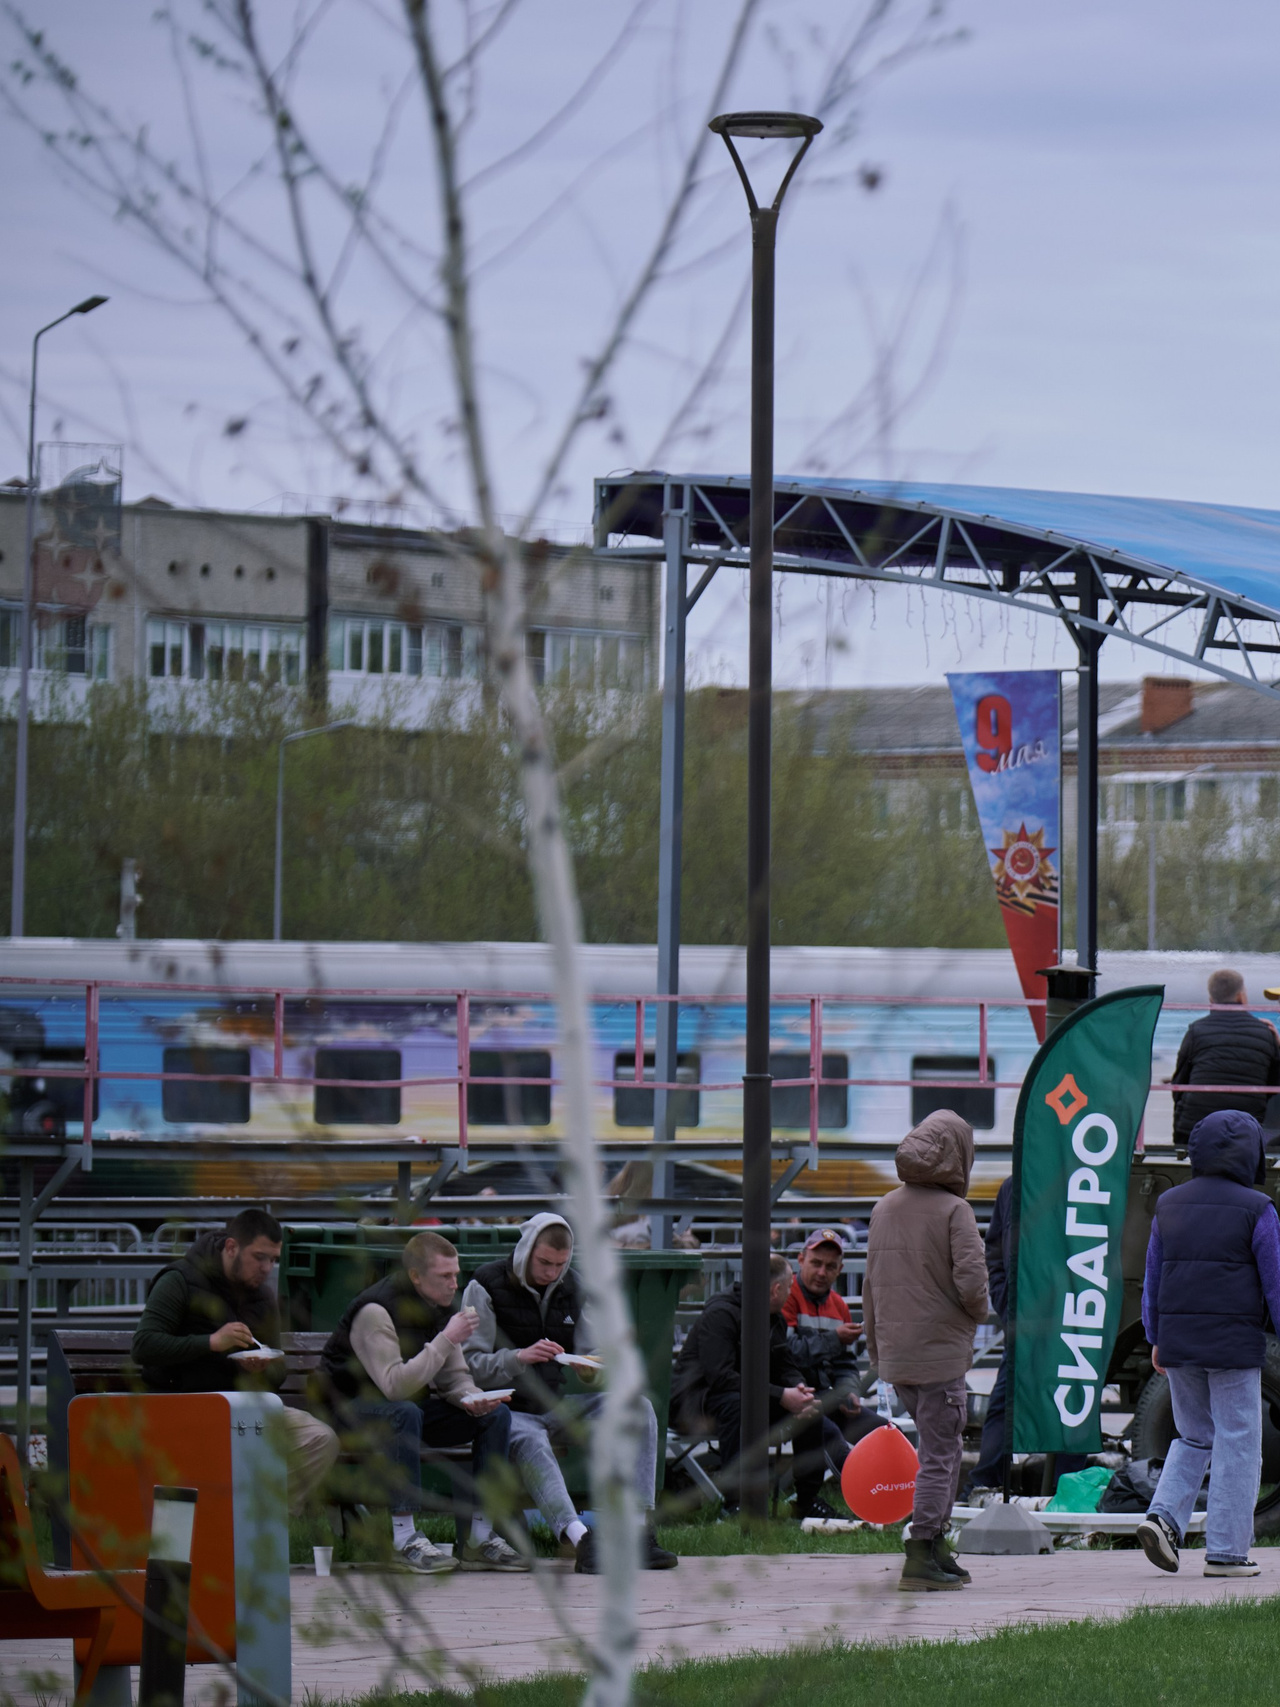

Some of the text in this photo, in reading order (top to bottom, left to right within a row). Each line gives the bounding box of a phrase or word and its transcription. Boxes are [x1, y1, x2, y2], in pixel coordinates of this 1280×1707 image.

[977, 693, 1049, 776] 9 мая
[1054, 1113, 1118, 1427] СИБАГРО
